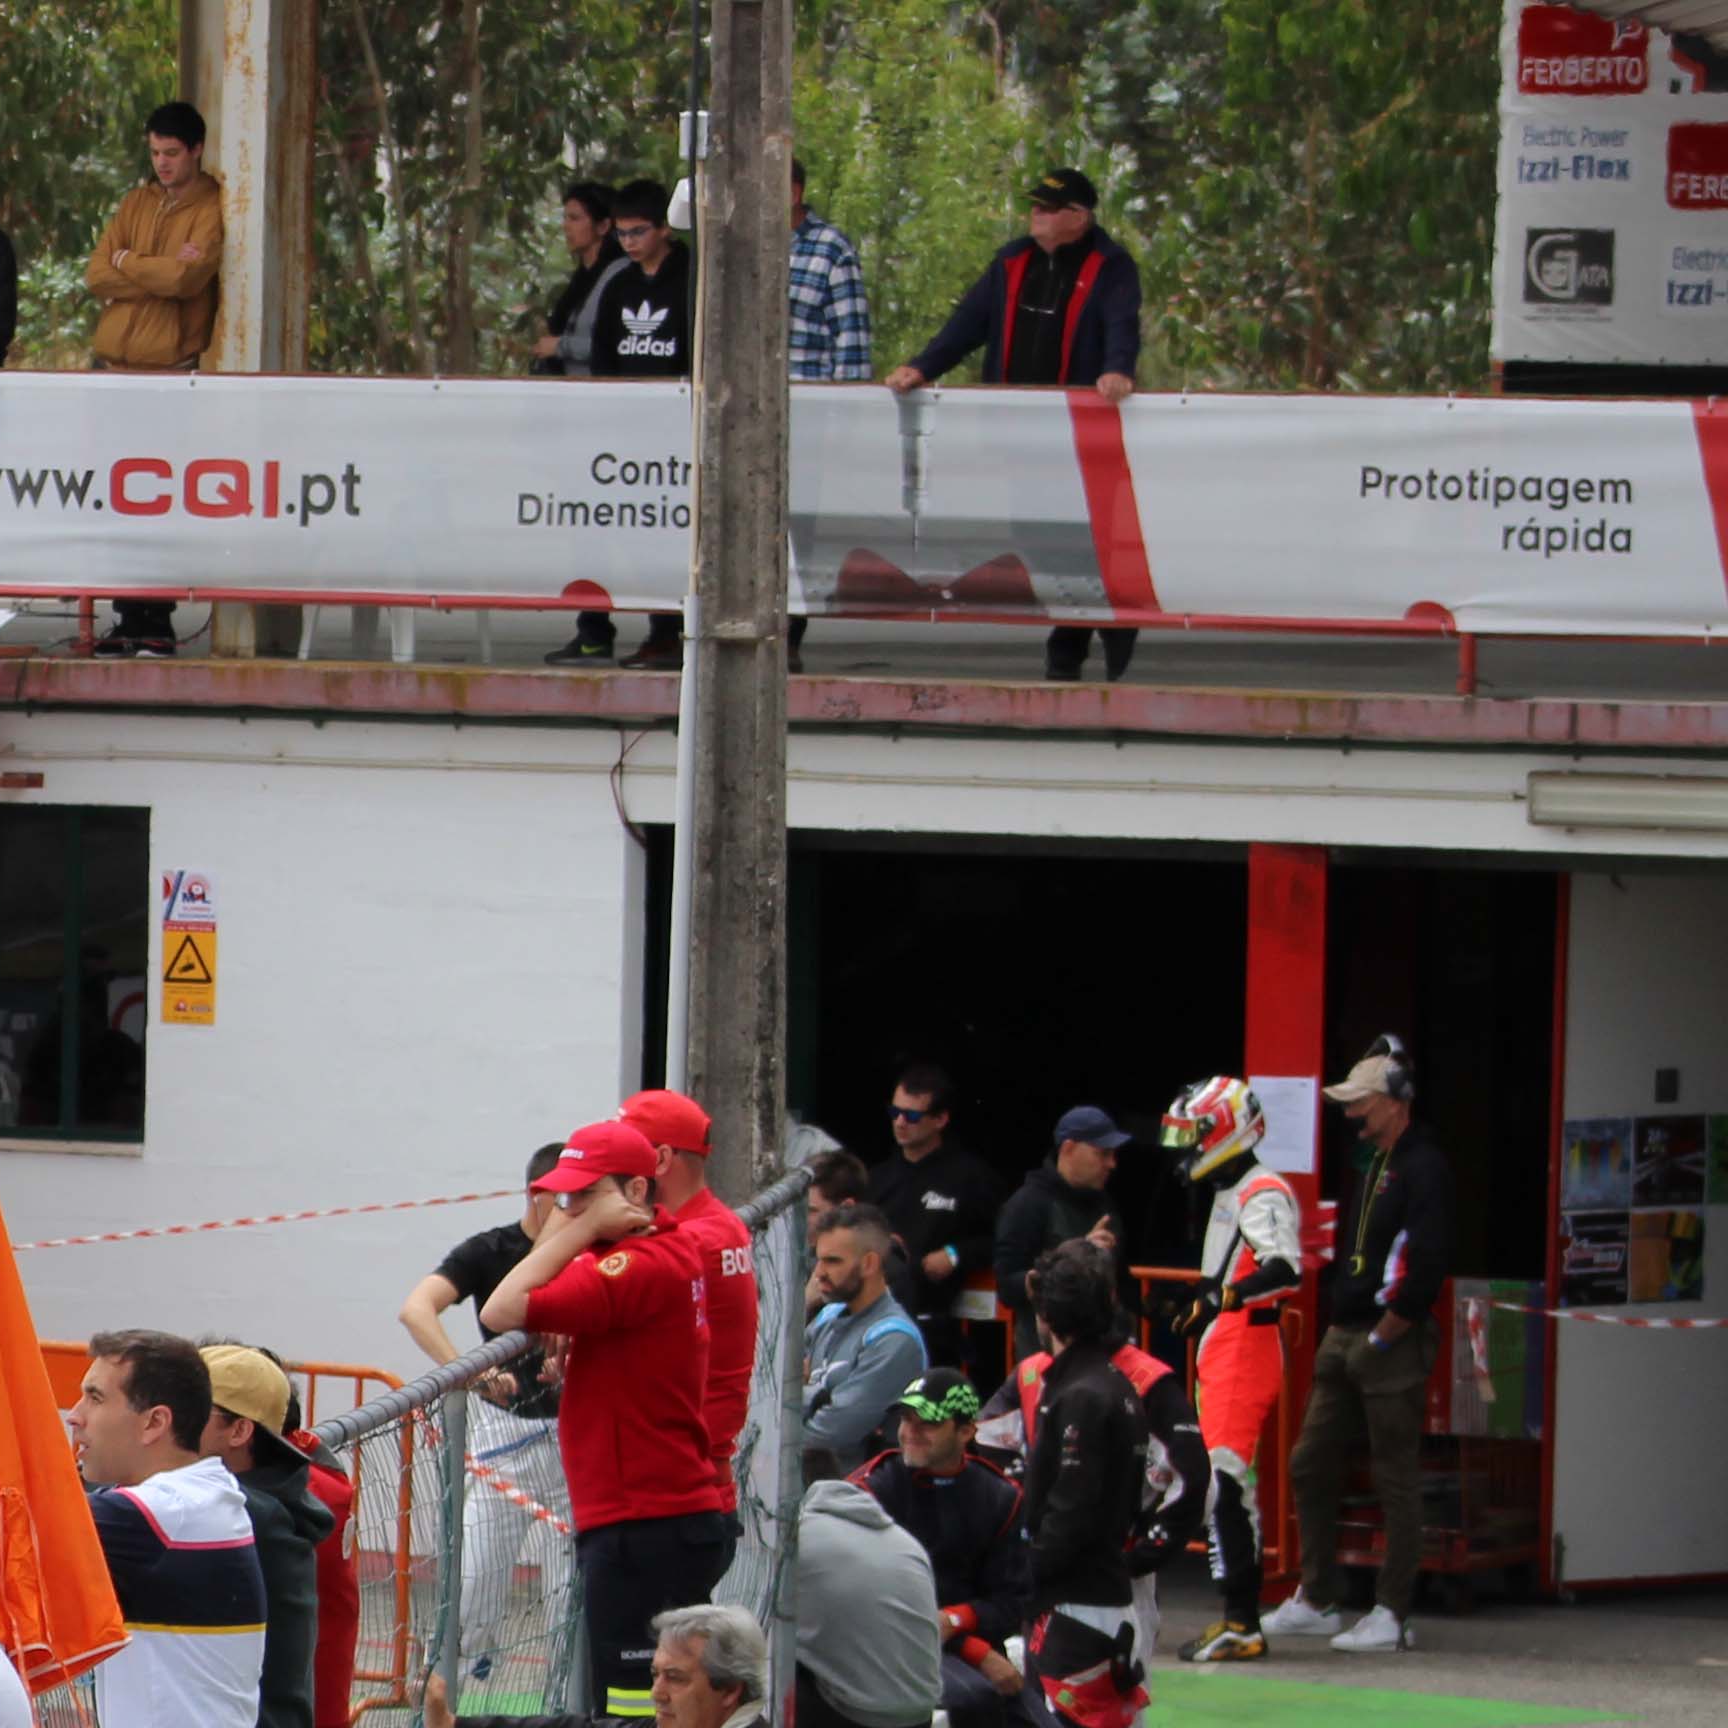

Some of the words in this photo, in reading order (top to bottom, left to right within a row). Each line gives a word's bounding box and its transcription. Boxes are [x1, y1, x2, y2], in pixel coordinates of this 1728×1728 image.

[1520, 56, 1643, 86] FERBERTO
[1580, 126, 1630, 148] Power
[617, 334, 676, 357] adidas
[1359, 465, 1633, 511] Prototipagem
[1501, 517, 1633, 558] rápida
